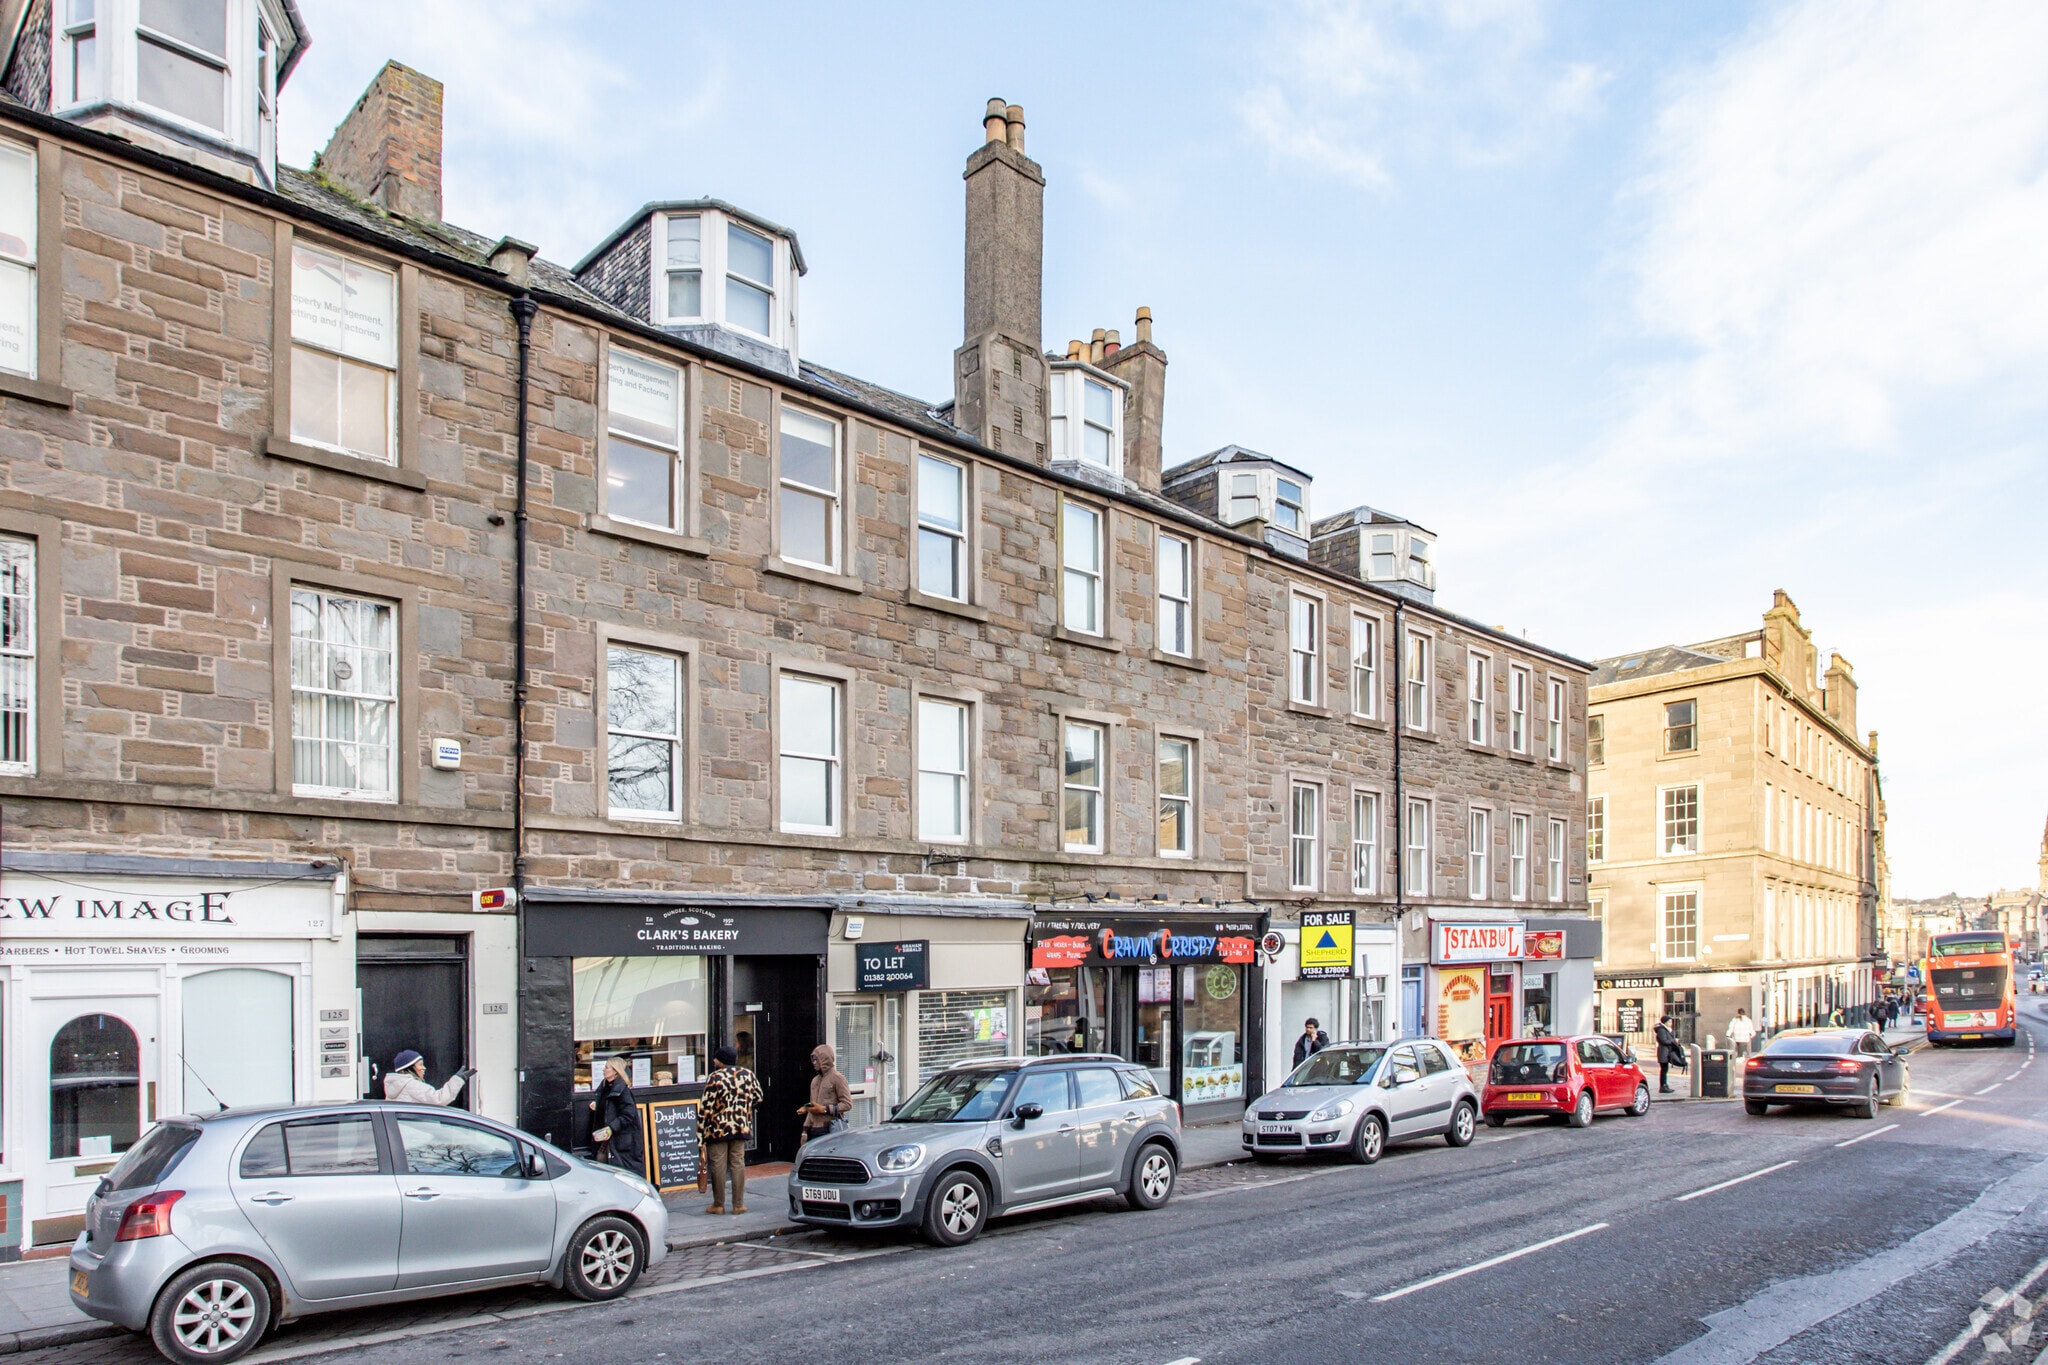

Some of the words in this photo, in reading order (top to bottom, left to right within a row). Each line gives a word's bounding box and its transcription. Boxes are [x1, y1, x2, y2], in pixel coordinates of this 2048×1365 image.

[320, 318, 337, 327] and
[624, 380, 637, 389] and
[638, 383, 670, 400] Factoring
[75, 892, 236, 924] IMAGE
[688, 907, 716, 919] SCOTLAND
[307, 919, 325, 928] 127
[1304, 914, 1323, 926] FOR
[1326, 912, 1350, 925] SALE
[637, 930, 689, 940] CLARK'S
[693, 930, 740, 940] BAKERY
[1160, 928, 1217, 958] CRRISPY
[1443, 927, 1519, 959] ISTANBUL
[65, 946, 86, 955] HOT
[88, 946, 125, 955] TOWEL
[126, 945, 167, 955] SHAVES
[180, 945, 230, 955] GROOMING
[1306, 948, 1347, 956] SHEPHERD
[863, 957, 881, 970] TO
[884, 956, 905, 970] LET
[864, 973, 885, 982] 01382
[886, 972, 914, 982] 200064
[1615, 978, 1660, 988] MEDINA
[489, 1004, 503, 1012] 125
[328, 1010, 344, 1019] 125
[655, 1106, 696, 1126] Doughnuts
[805, 1188, 822, 1199] ST69
